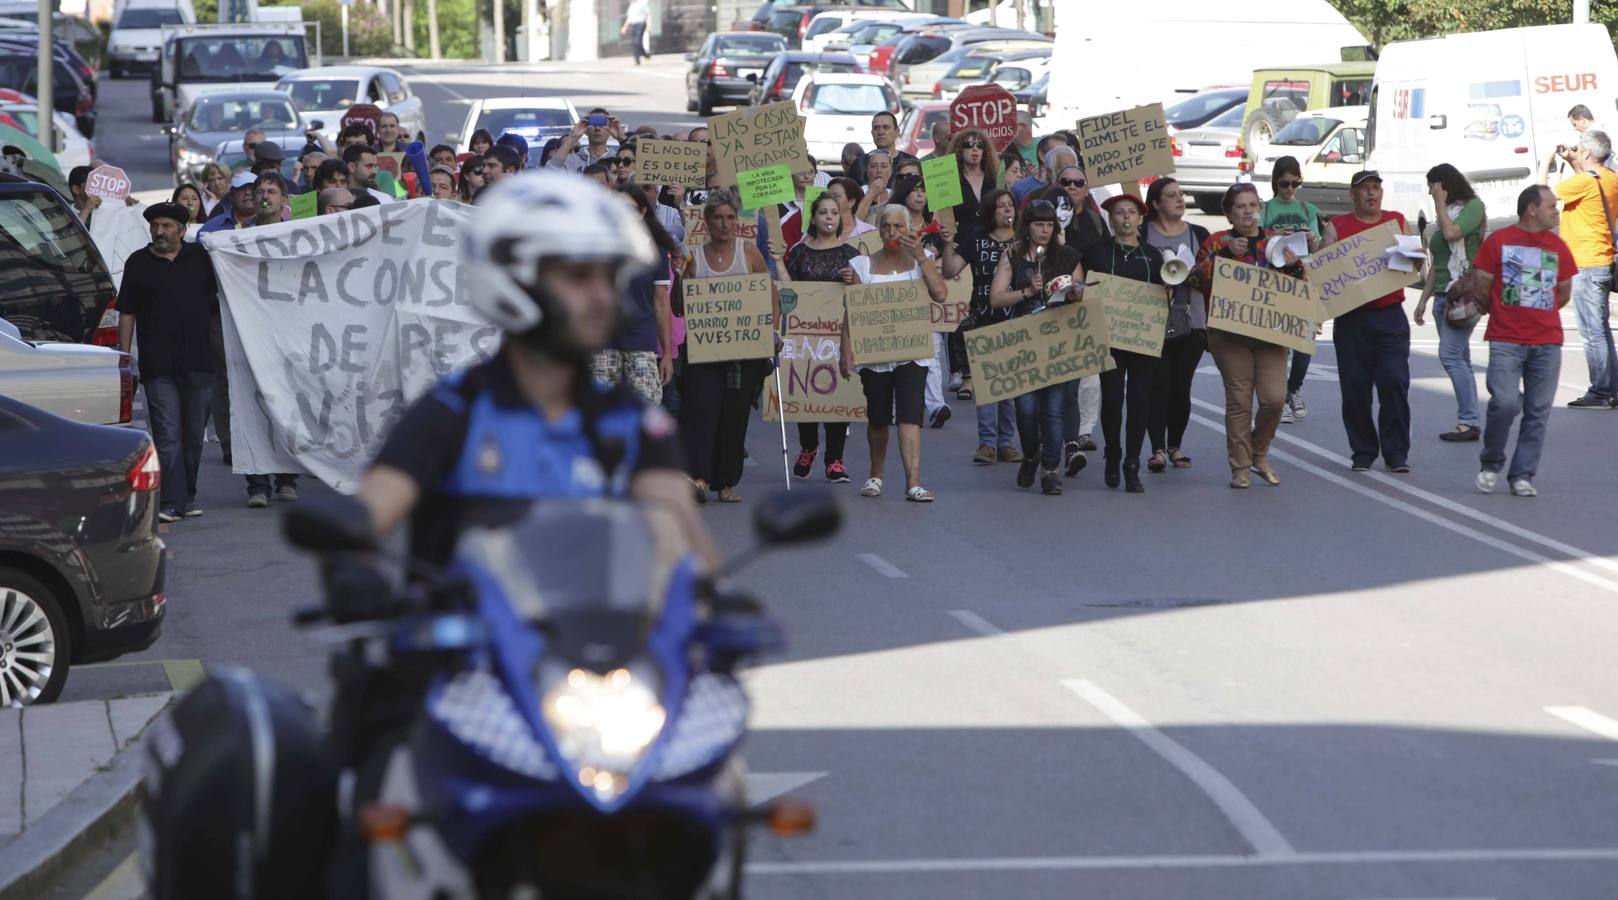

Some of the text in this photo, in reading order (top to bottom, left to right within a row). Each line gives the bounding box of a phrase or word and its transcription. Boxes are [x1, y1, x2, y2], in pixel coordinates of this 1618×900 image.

[1535, 73, 1598, 94] SEUR
[954, 98, 1012, 128] STOP
[713, 107, 797, 140] LAS CASAS
[984, 125, 1014, 138] UCIOS
[1080, 111, 1135, 138] FIDEL
[1084, 119, 1164, 149] DIMITE EL
[642, 143, 701, 156] EL NODO
[720, 138, 744, 158] YA
[733, 145, 800, 171] PAGADAS
[1088, 137, 1167, 167] NODO NO TE
[643, 160, 659, 170] ES
[664, 161, 681, 170] DE
[91, 173, 126, 193] STOP
[980, 251, 999, 262] DE
[257, 256, 477, 307] LA CONSE
[687, 284, 702, 296] EL
[748, 279, 767, 291] ES
[1218, 263, 1311, 300] COFRADIA
[687, 299, 742, 314] NUESTRO
[1251, 287, 1277, 306] DE
[687, 316, 729, 329] BARRIO
[736, 315, 751, 326] NO
[1039, 319, 1060, 336] es
[1067, 305, 1090, 330] el
[694, 328, 761, 344] VUESTRO
[1074, 333, 1096, 352] LA
[309, 322, 498, 376] DE PES
[802, 335, 840, 361] NO
[788, 357, 837, 398] NO
[803, 400, 866, 419] mueve
